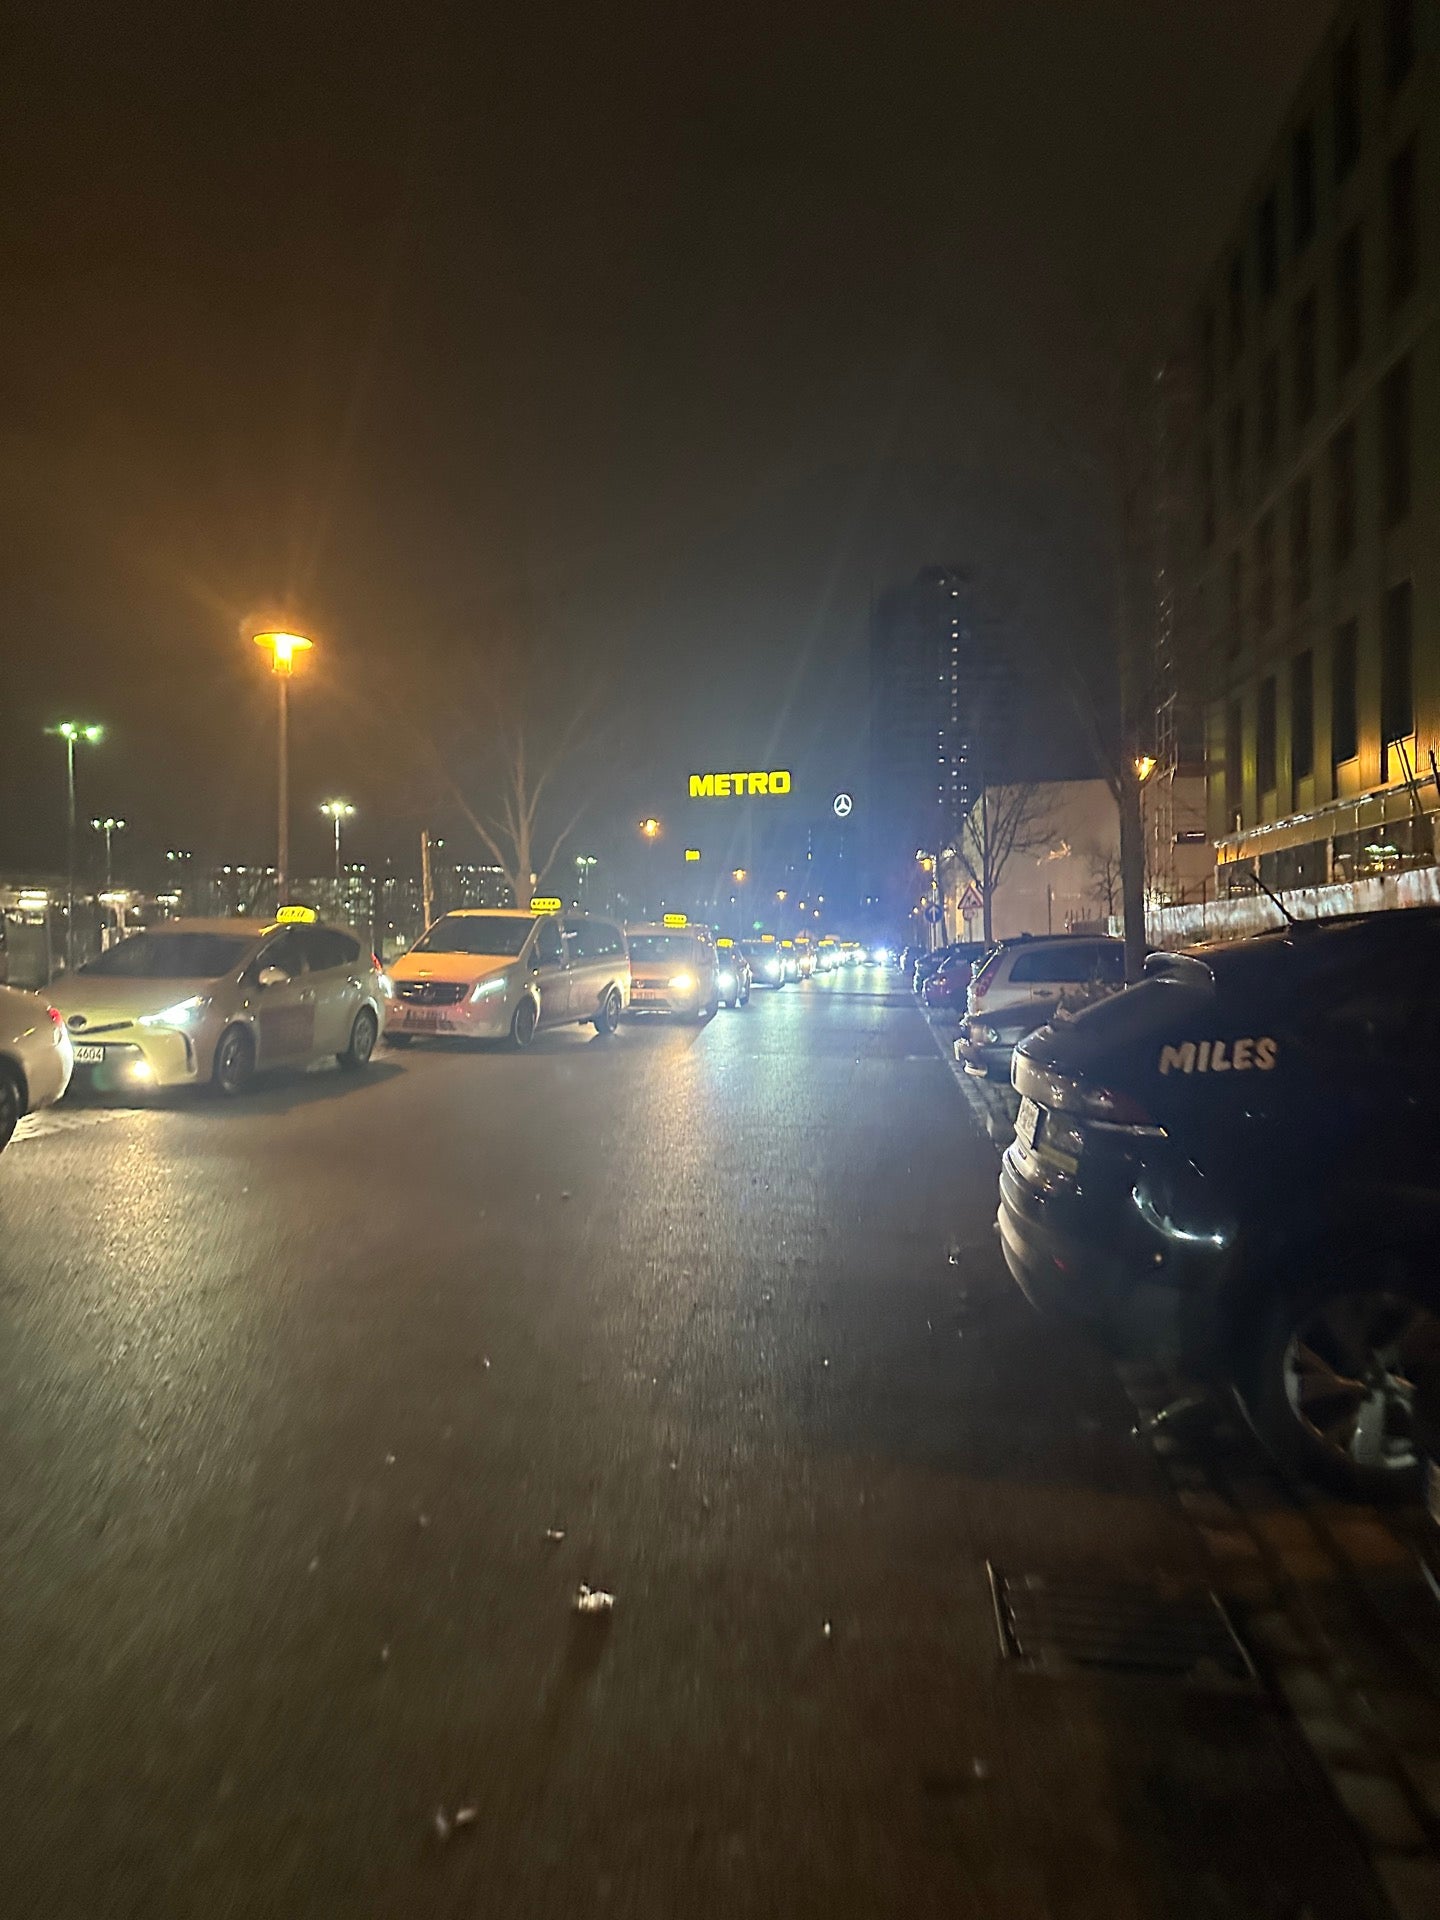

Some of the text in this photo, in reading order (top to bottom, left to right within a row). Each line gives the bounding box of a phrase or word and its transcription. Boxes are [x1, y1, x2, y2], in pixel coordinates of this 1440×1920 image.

[689, 771, 791, 797] METRO
[76, 1047, 102, 1060] 4604
[1159, 1036, 1278, 1076] MILES
